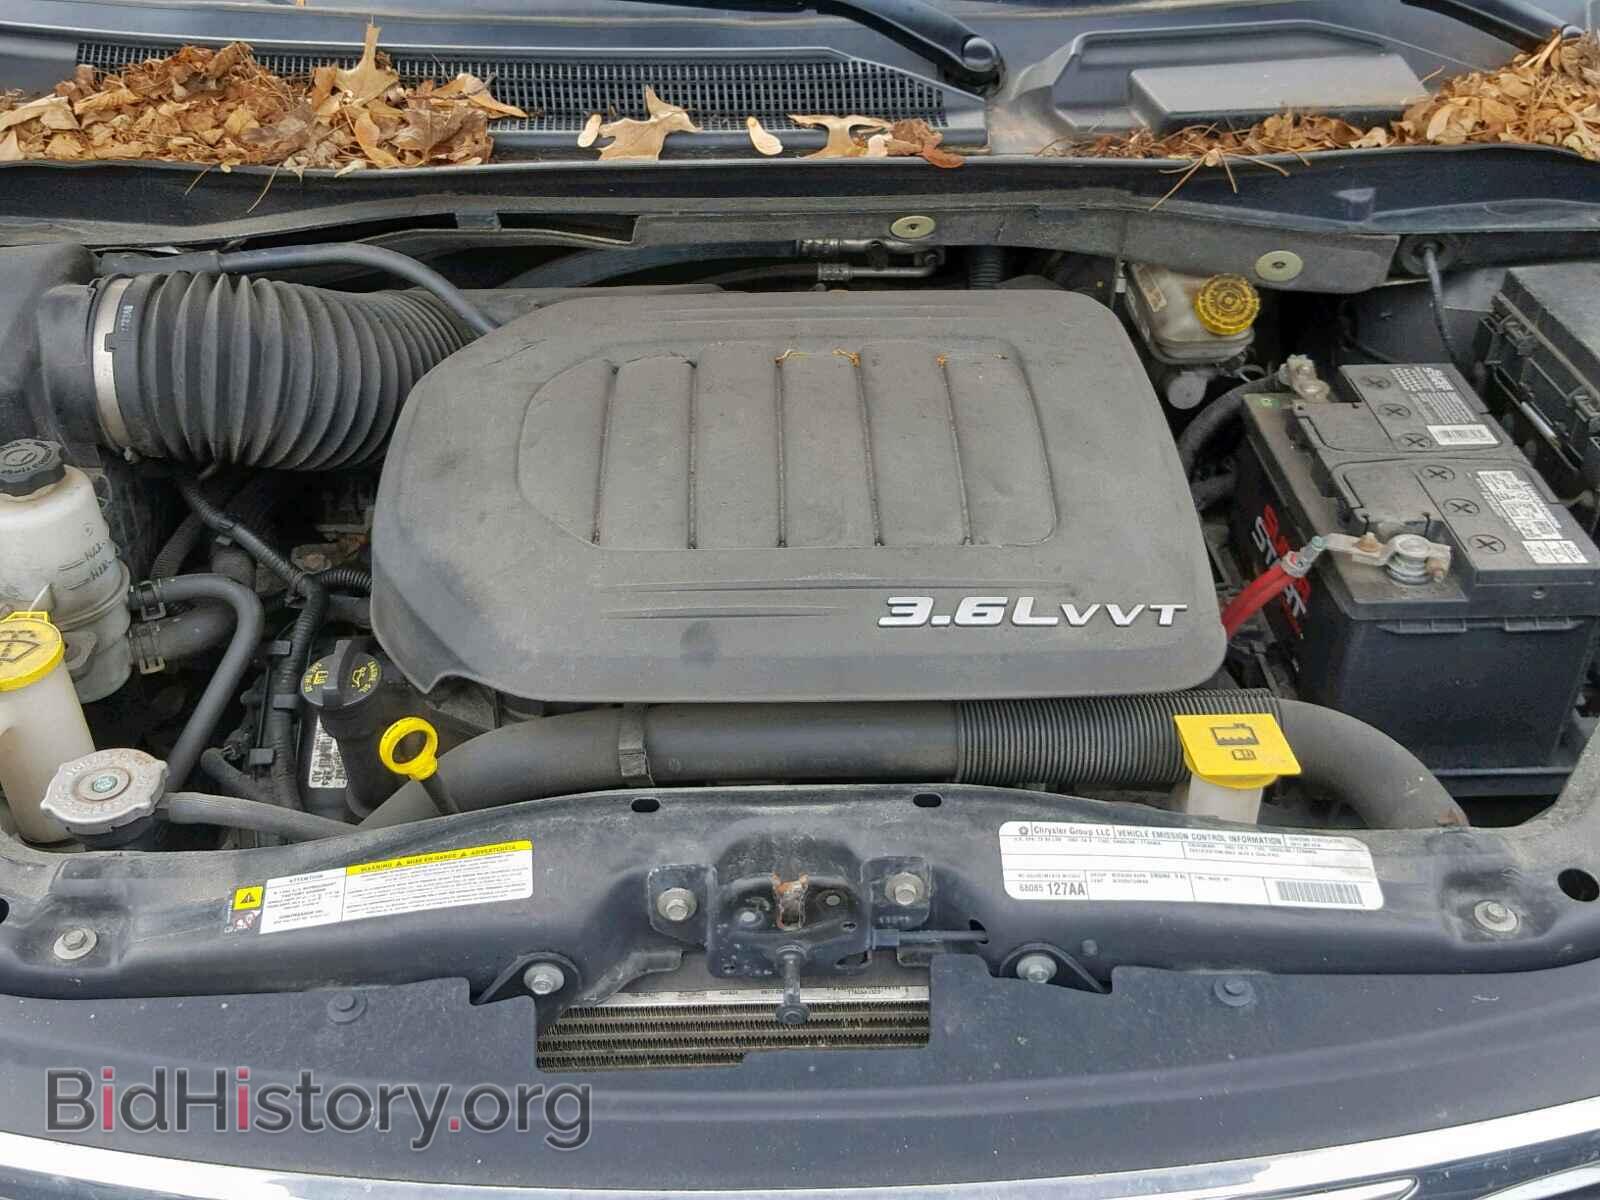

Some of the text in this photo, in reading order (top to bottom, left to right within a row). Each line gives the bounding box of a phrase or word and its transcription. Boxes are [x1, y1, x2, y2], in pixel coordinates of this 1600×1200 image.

[1034, 826, 1067, 836] Chrysler
[1069, 827, 1092, 837] Group
[1096, 828, 1110, 836] LLC
[1117, 830, 1149, 838] VEHICLE
[1152, 831, 1189, 840] EMISSION
[1192, 833, 1227, 842] CONTROL
[1230, 834, 1282, 845] INFORMATION
[1047, 881, 1086, 896] 127AA
